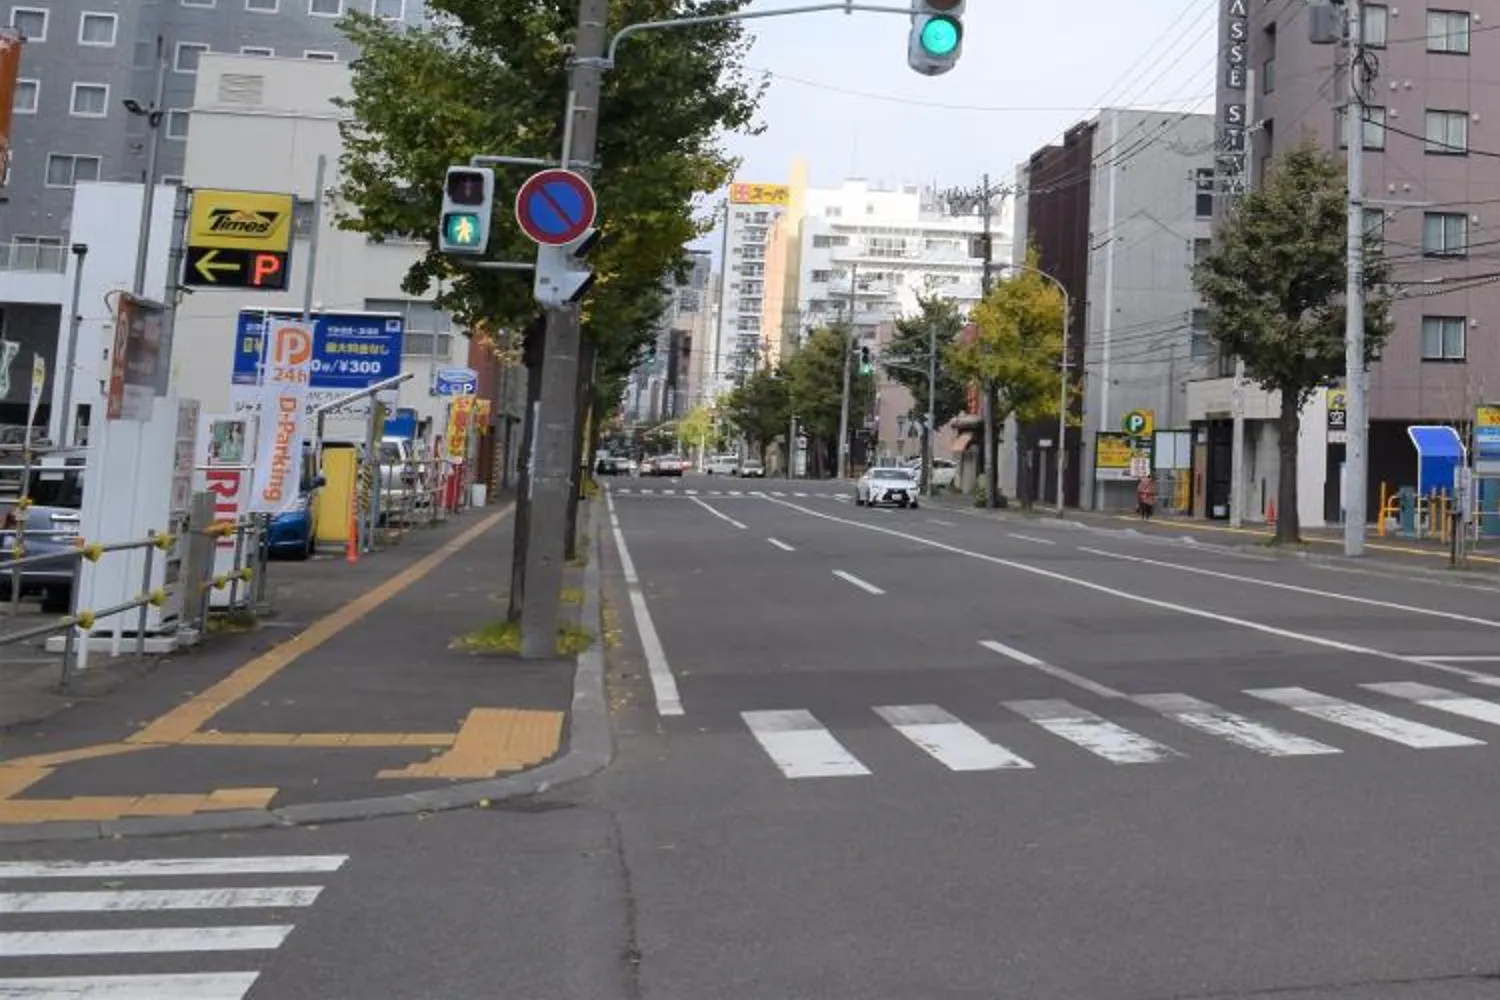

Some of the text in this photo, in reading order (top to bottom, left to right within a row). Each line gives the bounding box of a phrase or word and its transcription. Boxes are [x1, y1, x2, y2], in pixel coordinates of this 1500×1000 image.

[208, 208, 279, 233] Times
[254, 253, 281, 286] P
[273, 368, 307, 385] 24h
[1130, 414, 1144, 432] P
[263, 396, 298, 504] D-Parking
